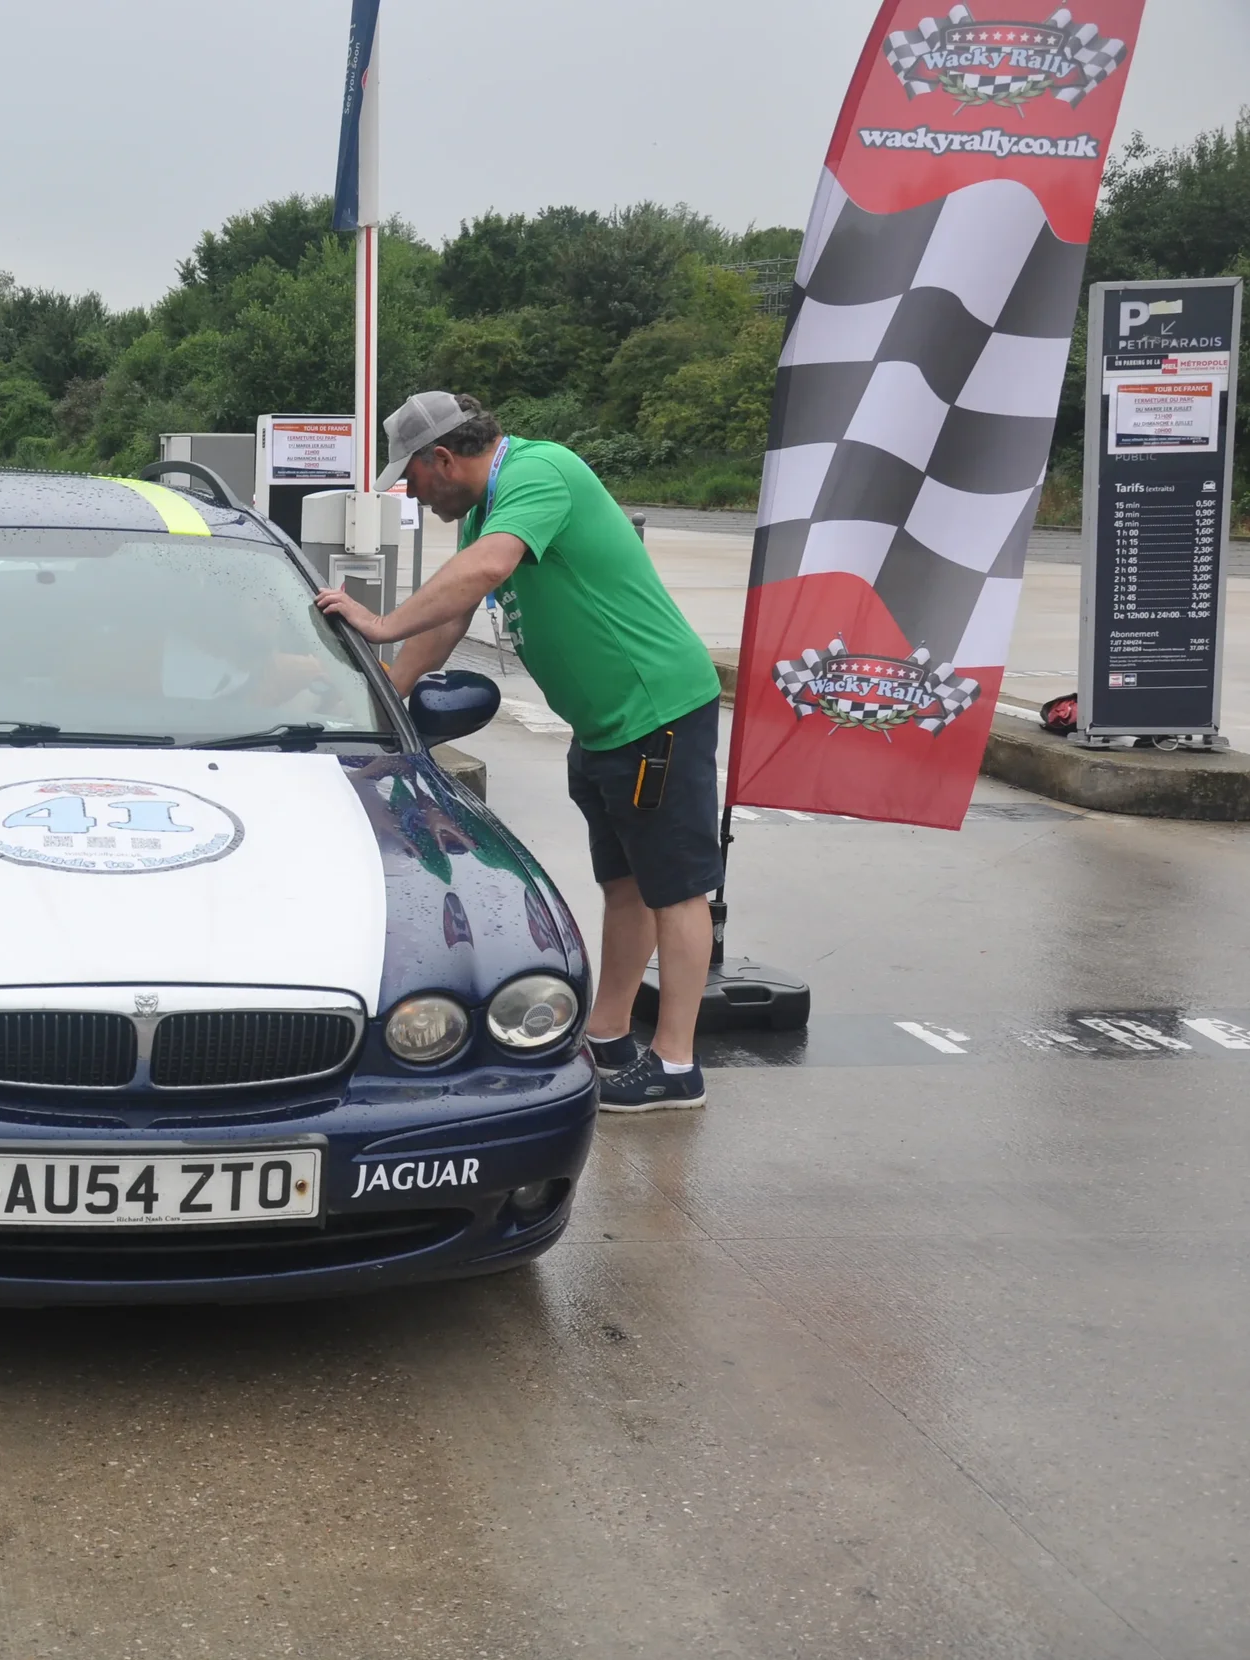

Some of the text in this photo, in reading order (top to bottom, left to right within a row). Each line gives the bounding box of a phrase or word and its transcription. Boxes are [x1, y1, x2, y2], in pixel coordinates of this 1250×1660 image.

[352, 42, 360, 69] soon
[923, 46, 1077, 78] Wacky Rally
[858, 126, 1098, 158] wackyrally.co.uk
[1119, 301, 1150, 336] P
[1119, 337, 1222, 350] PETIT PARADIS
[1180, 359, 1228, 367] MÉTROPOLE
[1115, 453, 1157, 462] PUBLIC
[1115, 482, 1175, 494] Tarifs (extraits)
[1114, 520, 1124, 528] 45
[1125, 520, 1139, 528] min
[1129, 538, 1138, 546] 15
[1128, 575, 1137, 583] 15
[1126, 603, 1136, 611] 00
[1126, 611, 1149, 619] 12h00
[1150, 611, 1155, 619] à
[808, 675, 937, 710] Wacky Rally
[2, 796, 195, 834] 41
[103, 859, 136, 869] to
[350, 1158, 480, 1199] JAGUAR
[3, 1160, 293, 1215] AU54 ZTO
[116, 1214, 182, 1224] Richard Nash Cars
